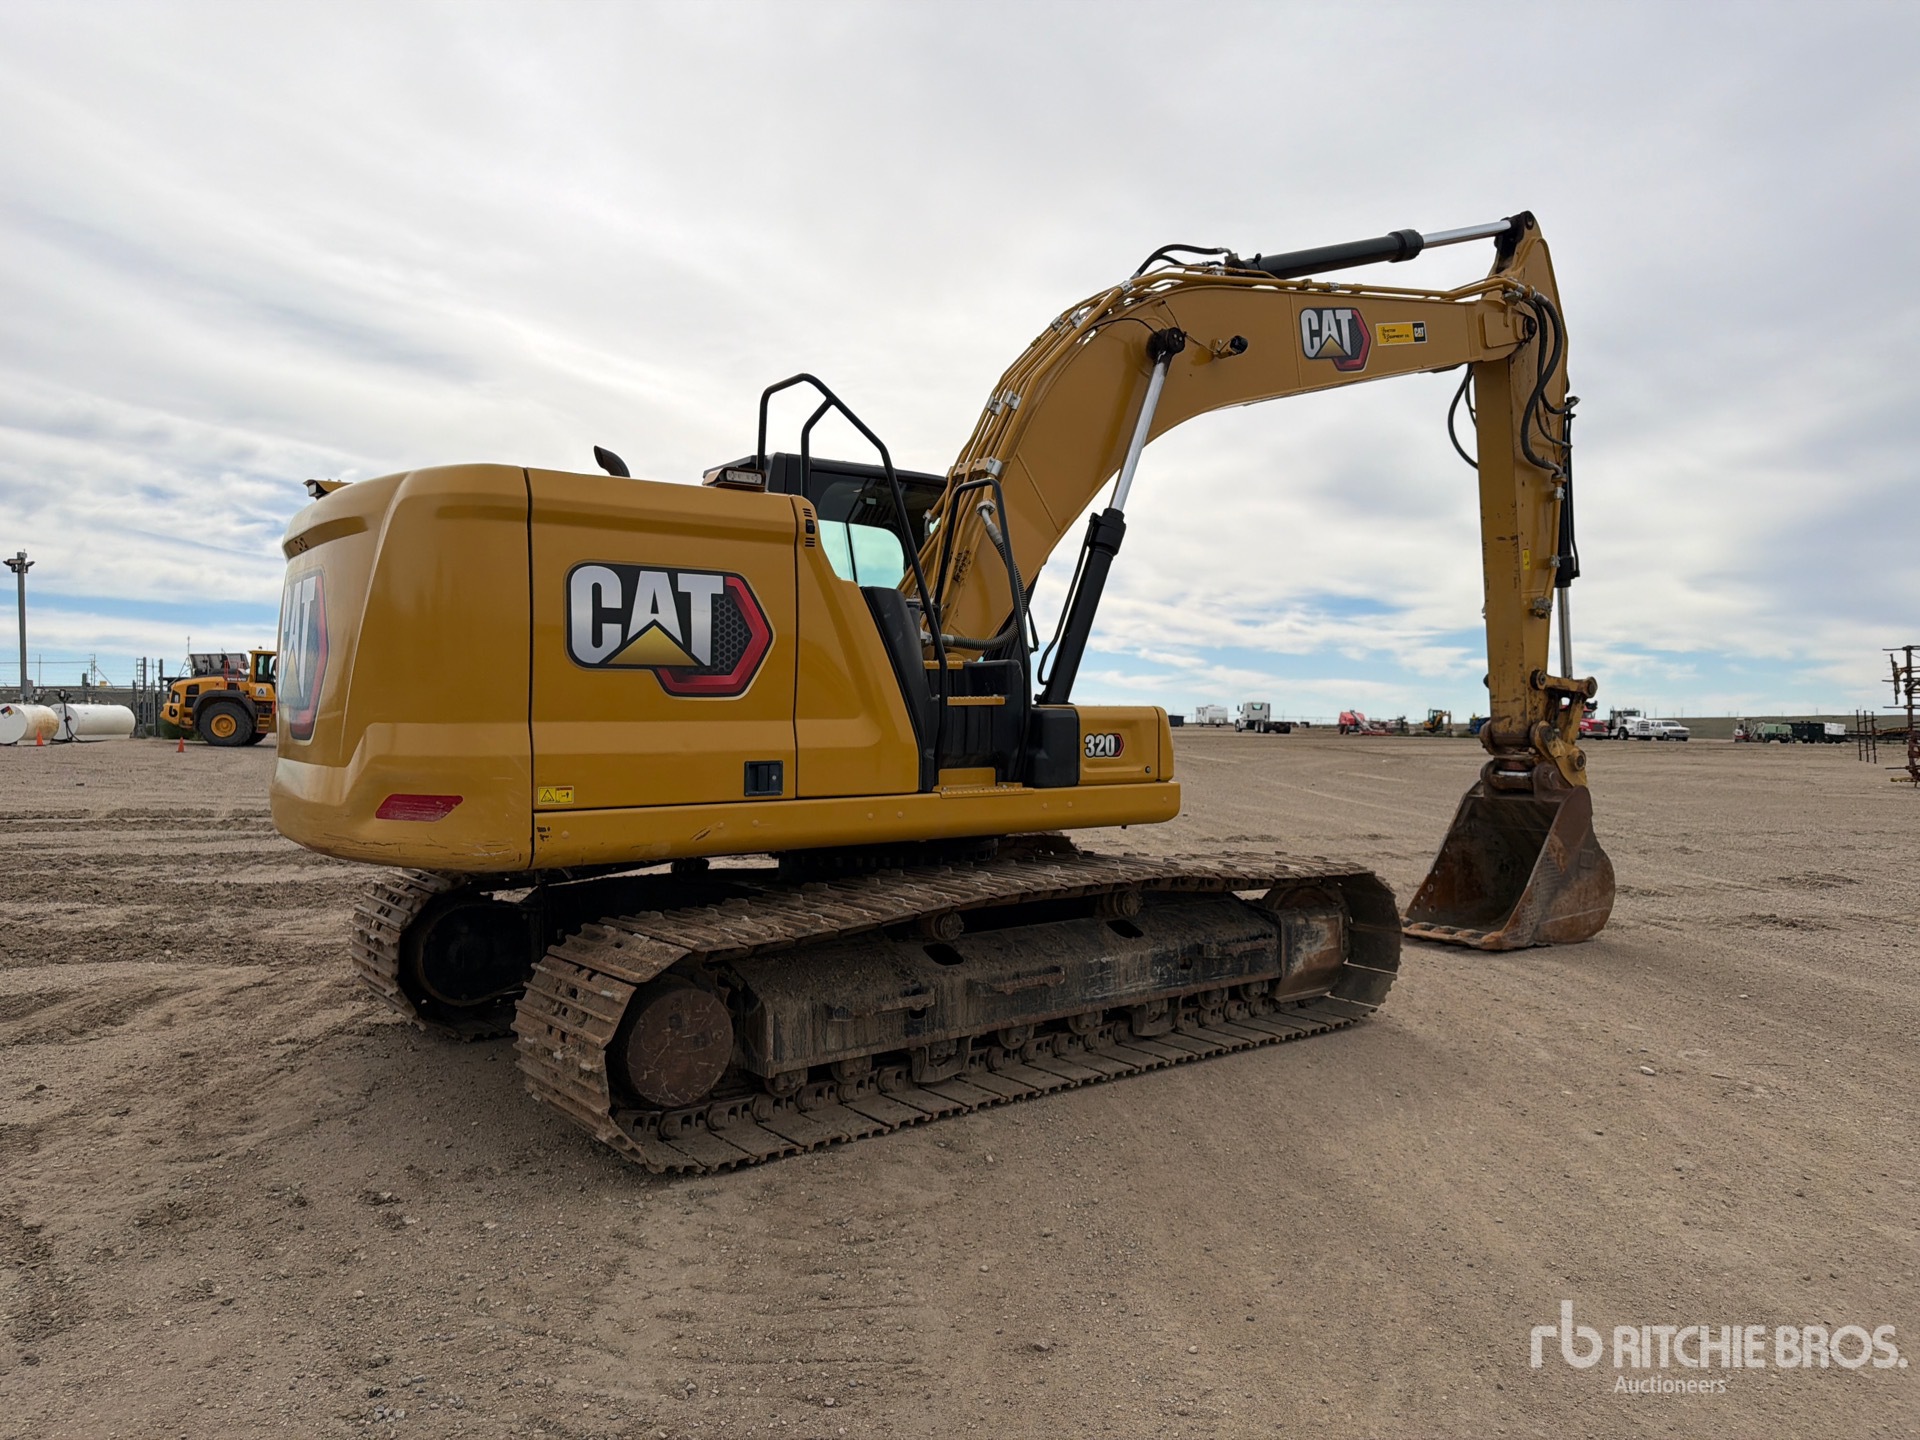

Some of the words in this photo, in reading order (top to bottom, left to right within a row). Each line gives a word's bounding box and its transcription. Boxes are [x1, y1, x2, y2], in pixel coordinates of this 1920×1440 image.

[1301, 309, 1352, 357] CAT
[278, 576, 316, 699] CAT
[569, 564, 723, 667] CAT
[1085, 734, 1115, 757] 320
